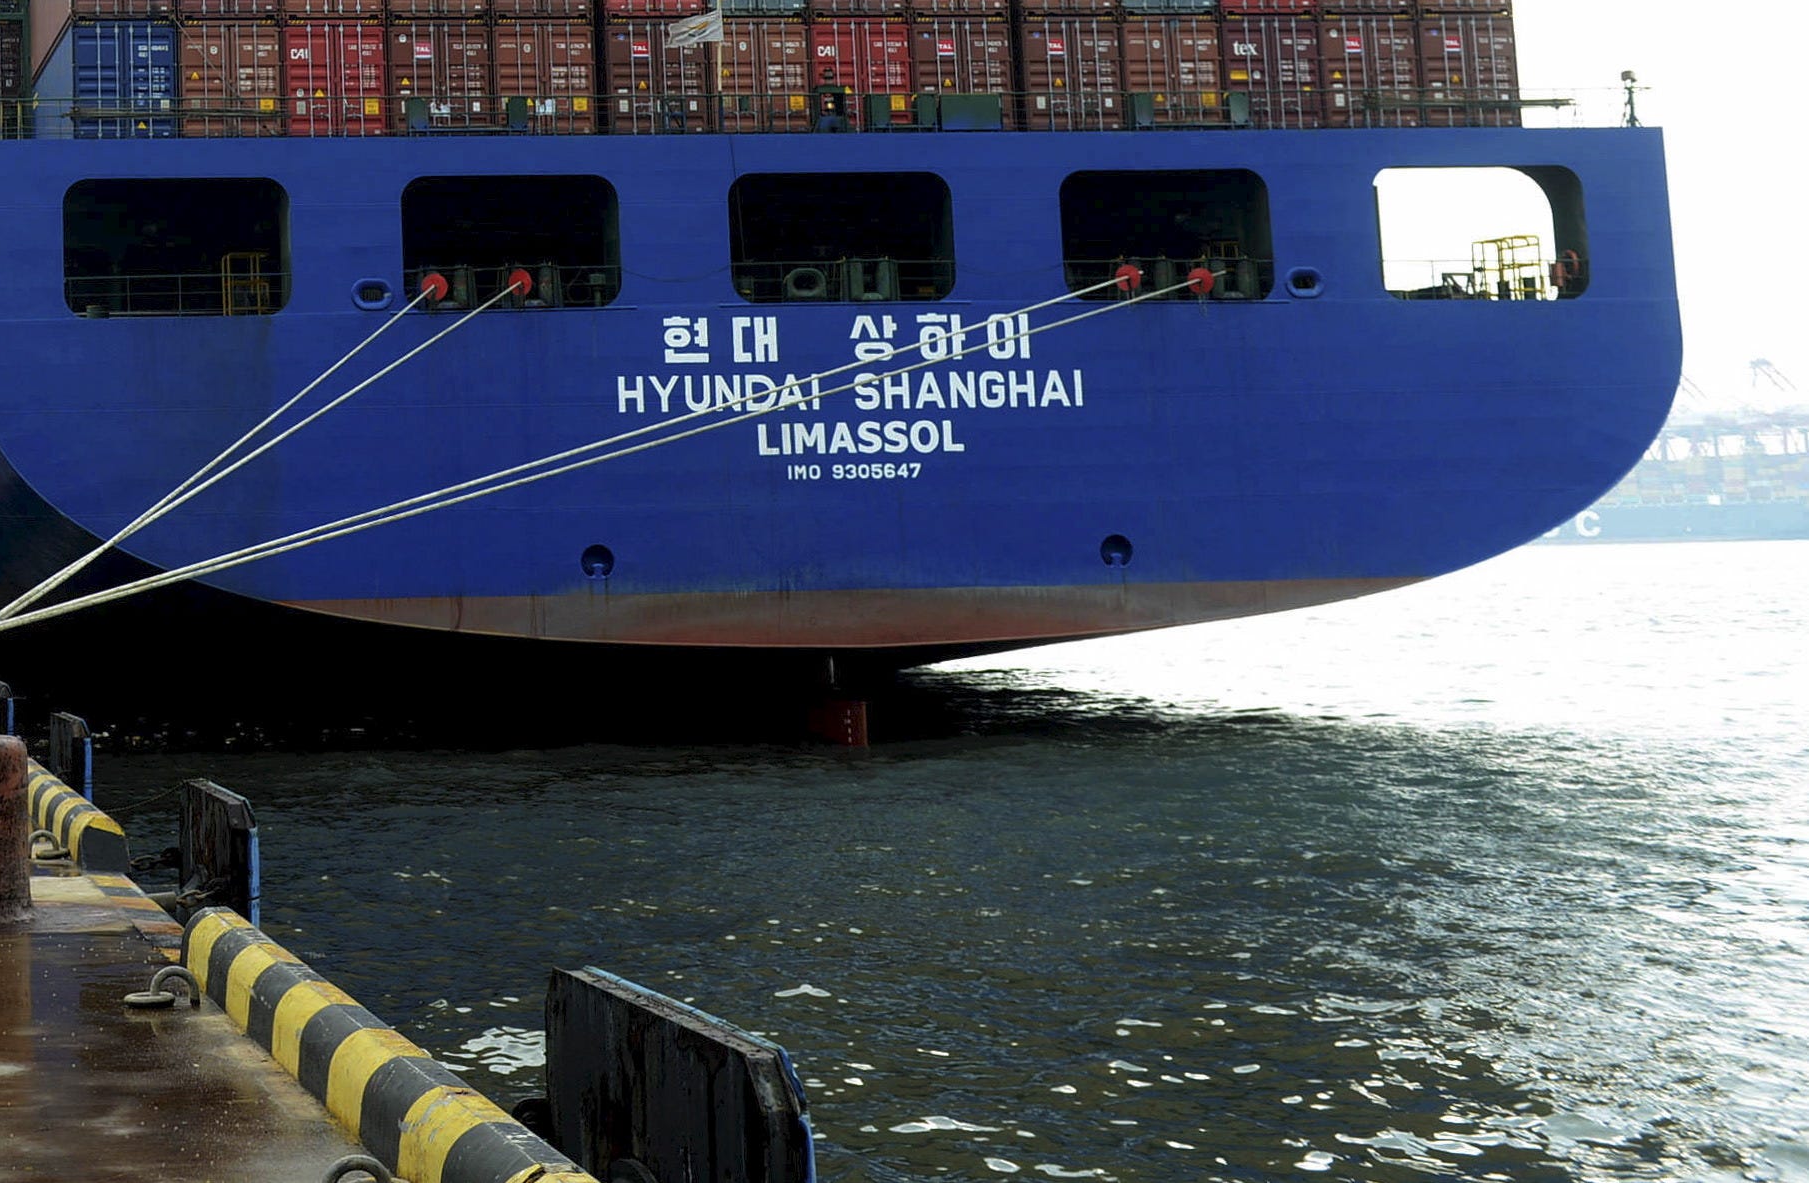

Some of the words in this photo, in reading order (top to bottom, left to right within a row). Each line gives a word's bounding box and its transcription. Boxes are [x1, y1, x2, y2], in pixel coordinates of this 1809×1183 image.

[291, 48, 309, 59] CAI
[633, 44, 648, 52] TAL
[817, 46, 835, 57] CAI
[1234, 40, 1258, 56] tex
[663, 315, 779, 364] 현대
[850, 312, 1031, 362] 상하이
[617, 372, 821, 414] HYUNDAI
[854, 368, 1084, 410] SHANGHAI
[757, 419, 965, 456] LIMASSOL
[787, 464, 822, 480] IMO
[832, 462, 922, 479] 9305647
